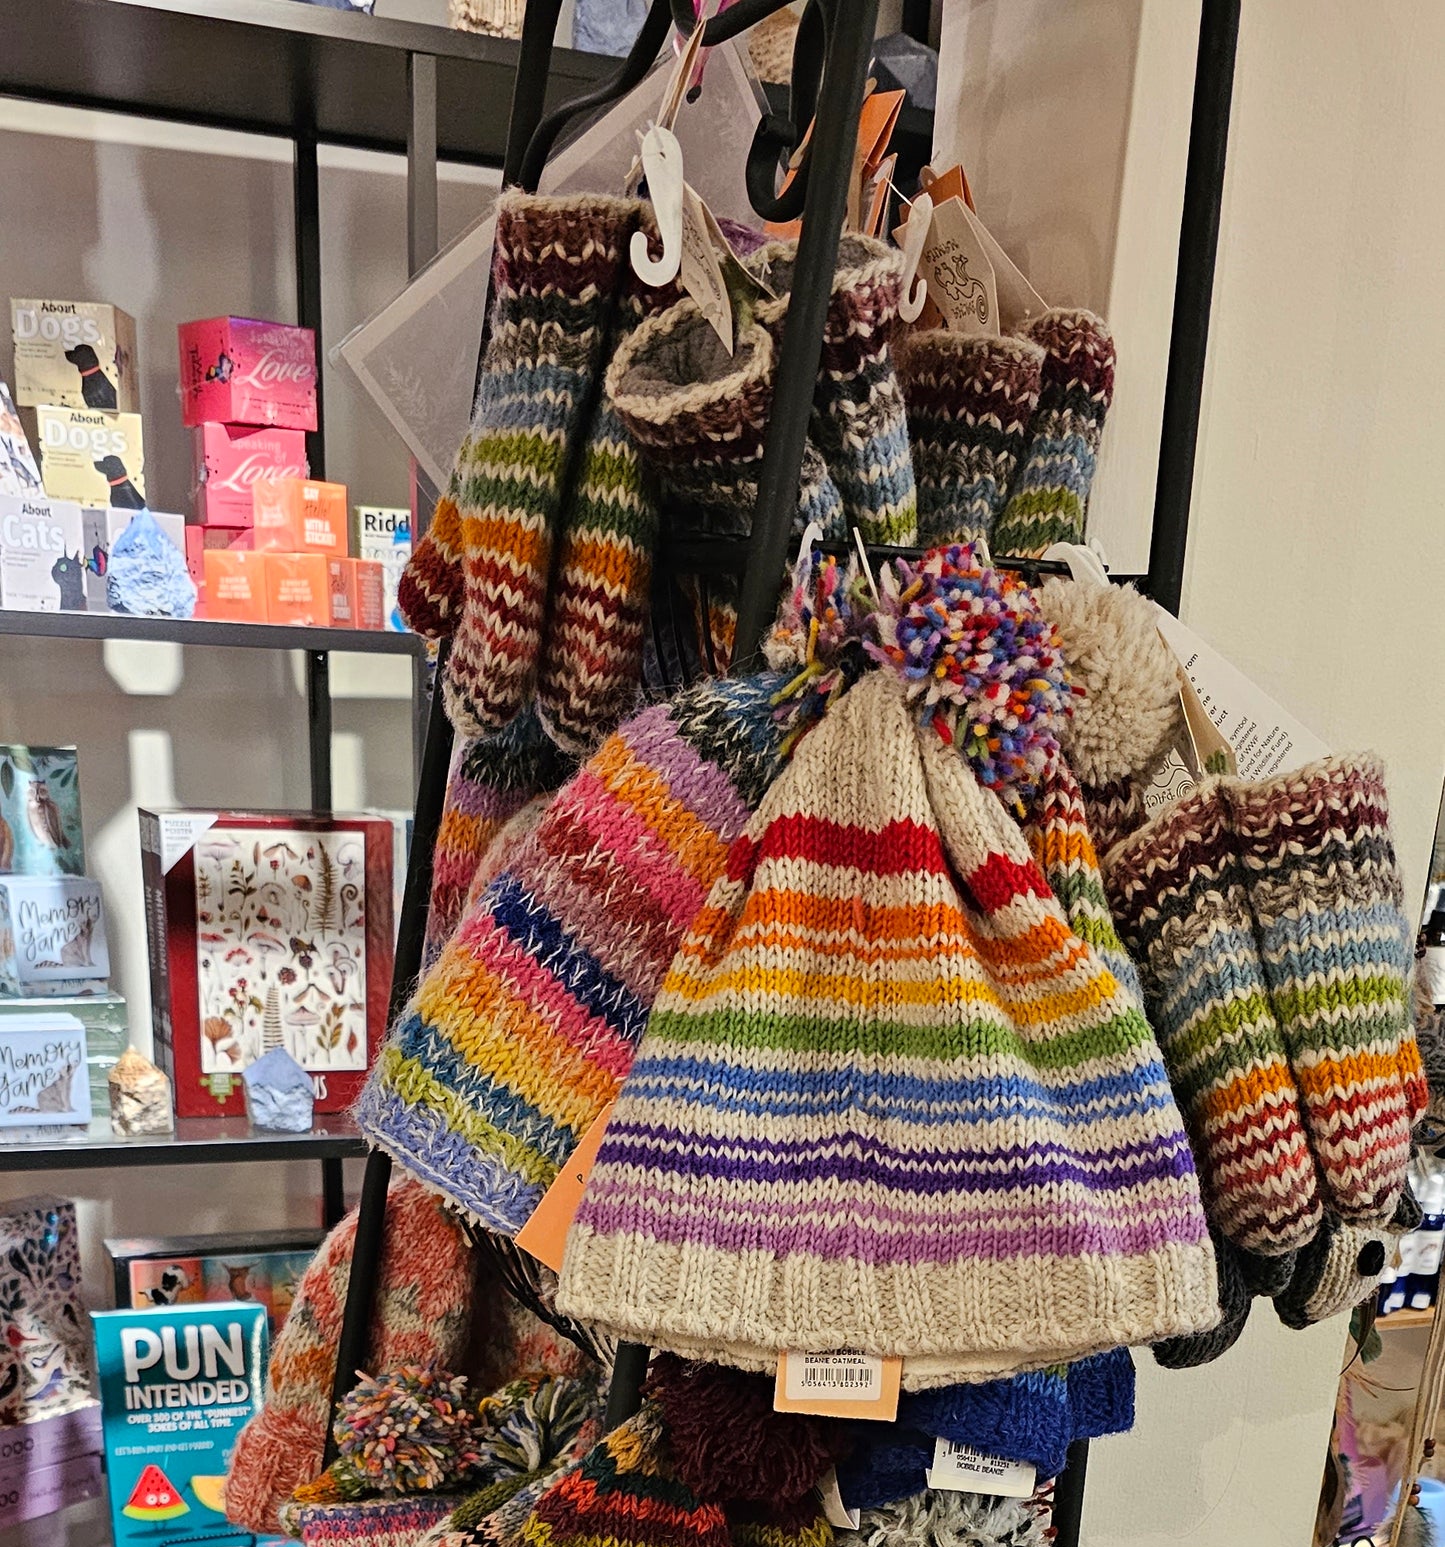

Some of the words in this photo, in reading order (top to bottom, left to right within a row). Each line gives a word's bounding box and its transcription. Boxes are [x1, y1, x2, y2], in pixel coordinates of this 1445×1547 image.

[41, 302, 77, 314] About
[16, 309, 101, 351] Dogs
[234, 348, 312, 390] Love
[70, 412, 105, 425] About
[44, 418, 128, 462] Dogs
[22, 503, 52, 517] About
[2, 514, 66, 550] Cats
[1230, 716, 1248, 741] symbol
[1243, 734, 1259, 755] WWF
[1240, 758, 1256, 777] Fund
[1253, 748, 1263, 759] for
[1261, 726, 1280, 749] Nature
[1253, 752, 1273, 776] Wildlife
[1270, 731, 1289, 753] Fund)
[1267, 741, 1294, 775] registered
[18, 896, 101, 930] Memory
[22, 921, 81, 962] game
[120, 1322, 246, 1383] PUN
[831, 1357, 867, 1365] OATMEAL
[124, 1380, 250, 1411] INTENDED
